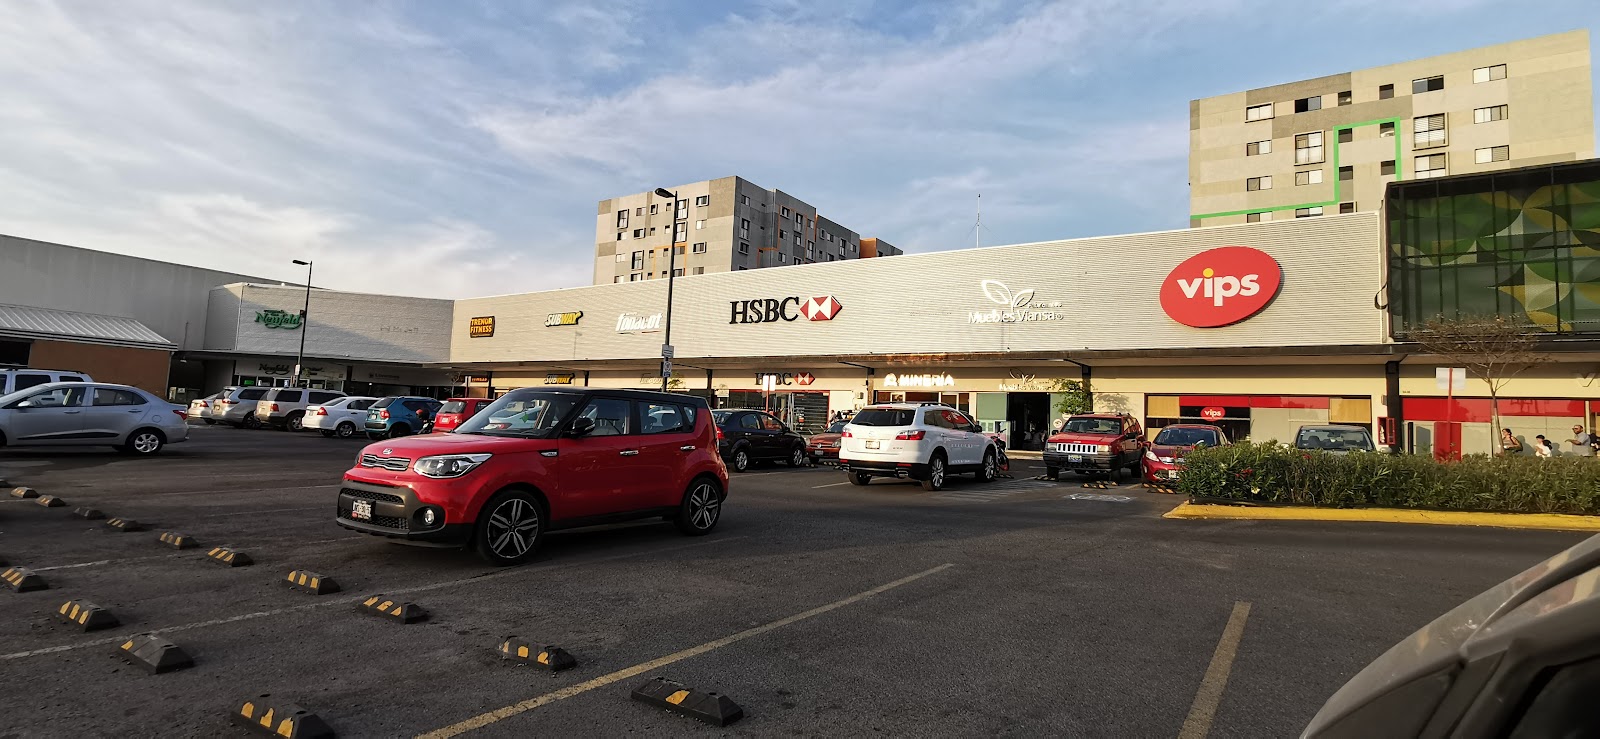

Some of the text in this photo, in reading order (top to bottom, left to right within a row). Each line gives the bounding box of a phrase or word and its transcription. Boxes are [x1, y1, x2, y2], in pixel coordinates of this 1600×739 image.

[1177, 267, 1260, 307] vips
[729, 296, 799, 324] HSBC
[968, 309, 1055, 324] Muebles Viansa
[544, 311, 583, 327] SUBWAY
[615, 312, 662, 331] fonacot
[470, 325, 492, 333] FITNESS
[755, 372, 792, 385] HBC
[898, 371, 955, 387] MINERÍA
[1204, 408, 1222, 418] vips
